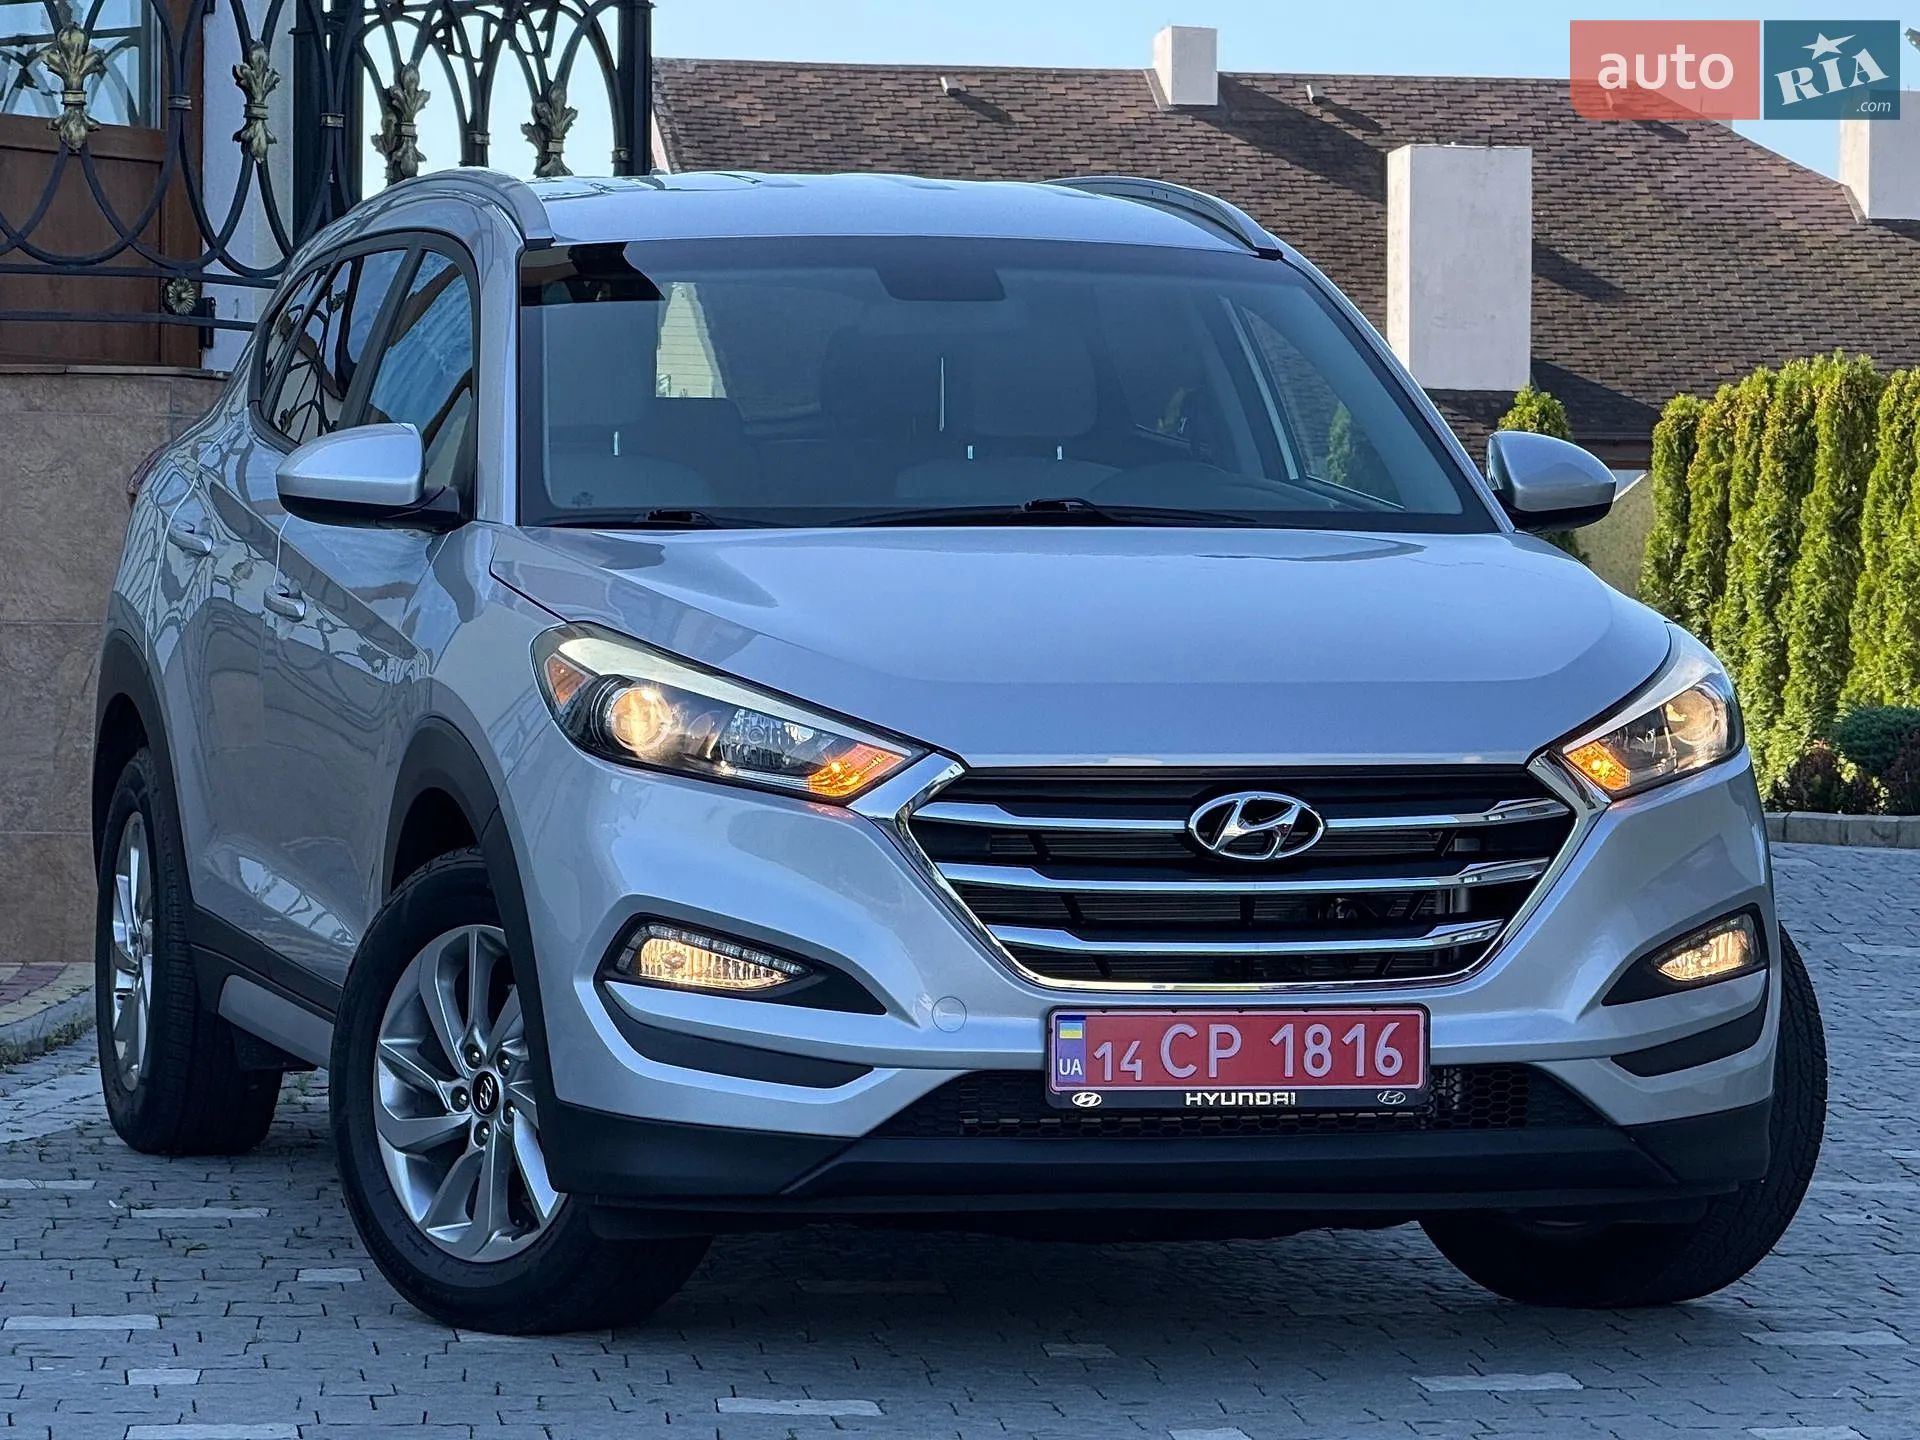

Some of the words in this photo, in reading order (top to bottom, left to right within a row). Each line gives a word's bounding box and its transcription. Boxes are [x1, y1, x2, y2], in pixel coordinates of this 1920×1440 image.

[1094, 1040, 1143, 1081] 14
[1160, 1023, 1242, 1078] CP
[1270, 1022, 1403, 1078] 1816
[1059, 1058, 1083, 1076] UA
[1185, 1092, 1297, 1106] HYUNDAI
